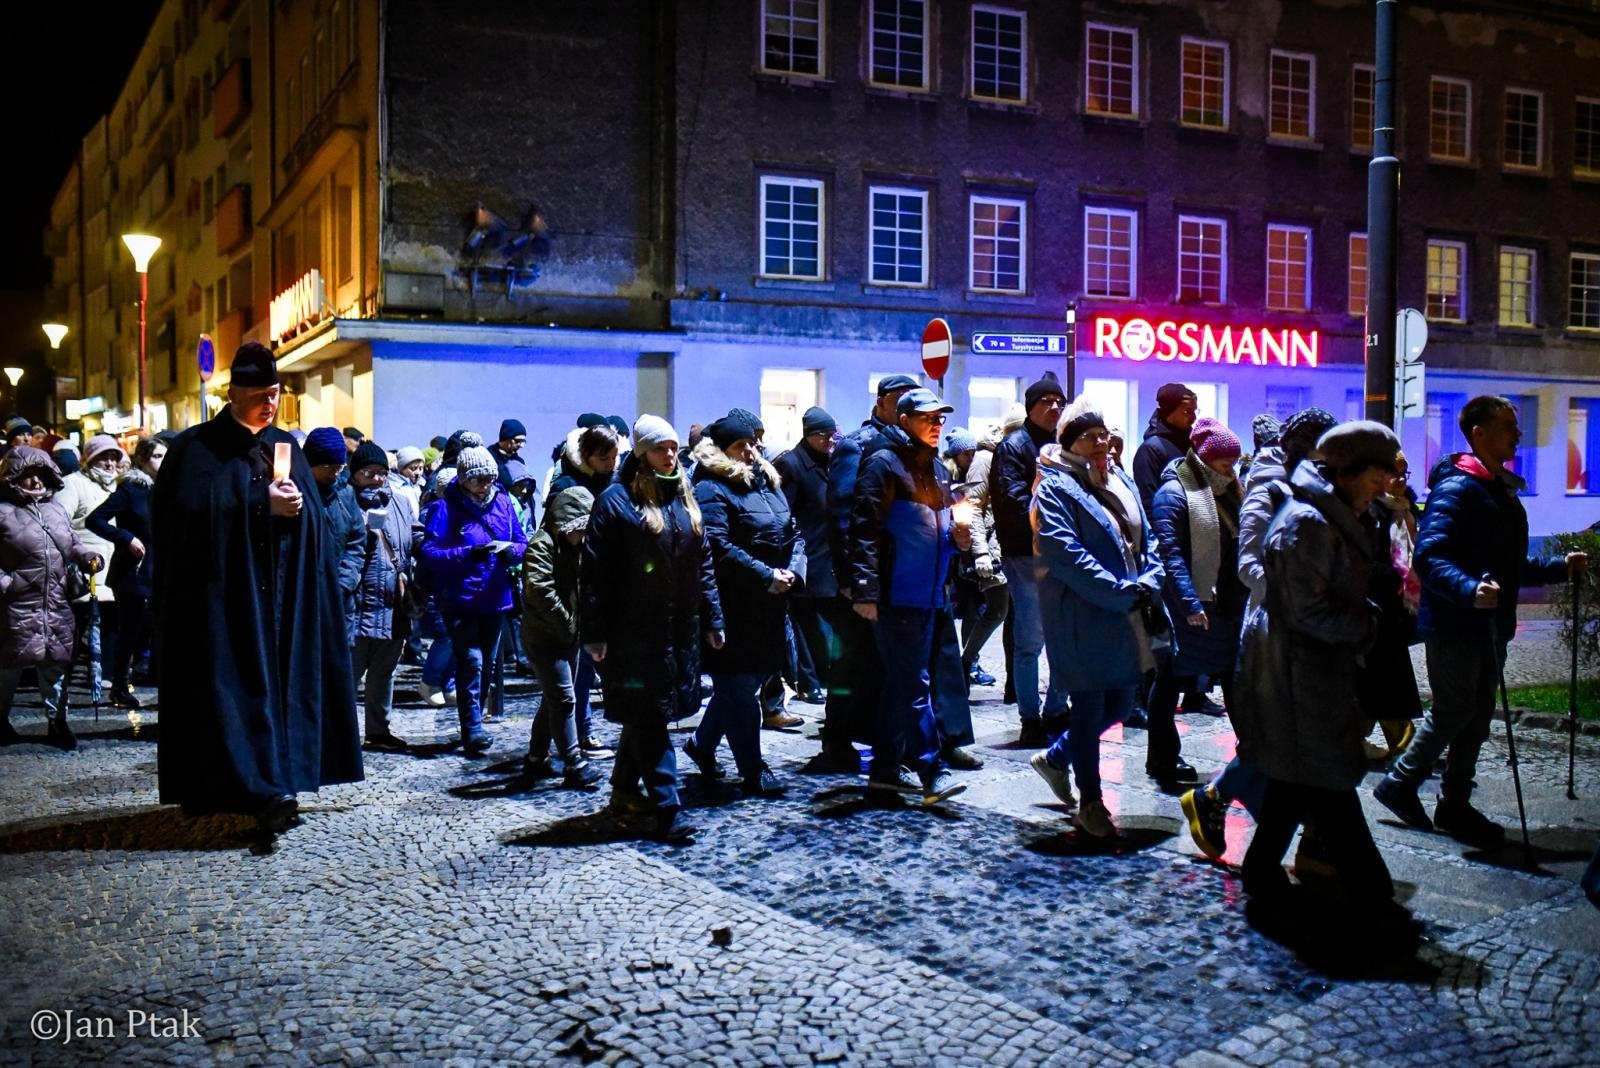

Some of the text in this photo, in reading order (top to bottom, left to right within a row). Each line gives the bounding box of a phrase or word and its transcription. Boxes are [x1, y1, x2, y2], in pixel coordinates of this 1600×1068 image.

[1011, 336, 1044, 344] Informacja
[1095, 317, 1318, 368] ROSSMANN
[1012, 343, 1045, 351] Turystyczna
